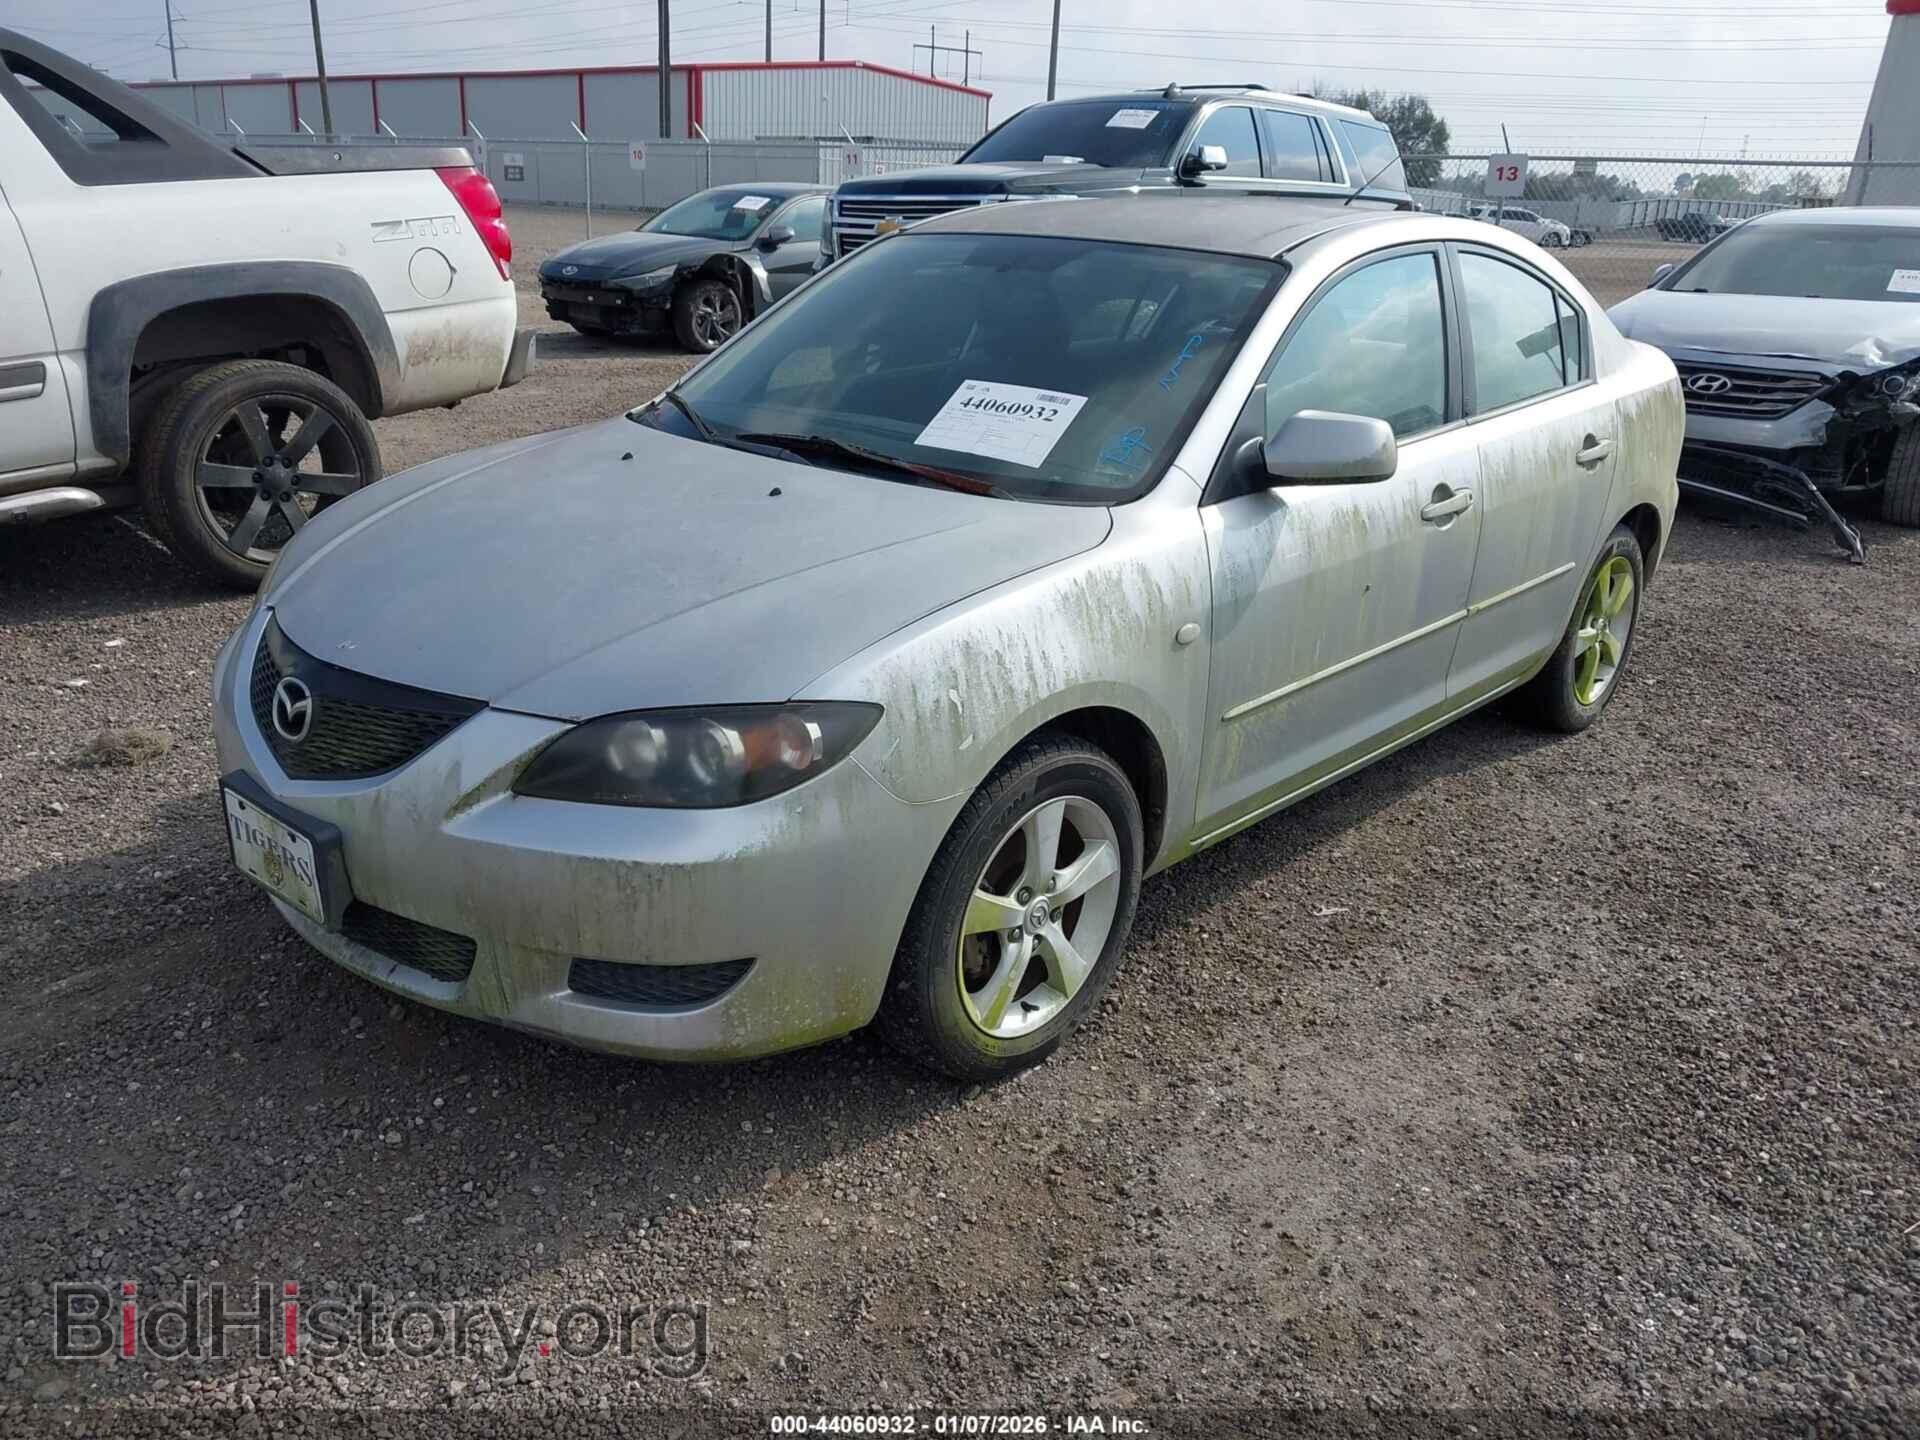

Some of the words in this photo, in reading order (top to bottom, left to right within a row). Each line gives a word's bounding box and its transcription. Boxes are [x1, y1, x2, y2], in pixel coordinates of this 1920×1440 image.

[633, 150, 643, 161] 10
[847, 153, 857, 165] 11
[1496, 166, 1519, 181] 13
[960, 395, 1059, 423] 44060932
[230, 813, 313, 888] TIGERS
